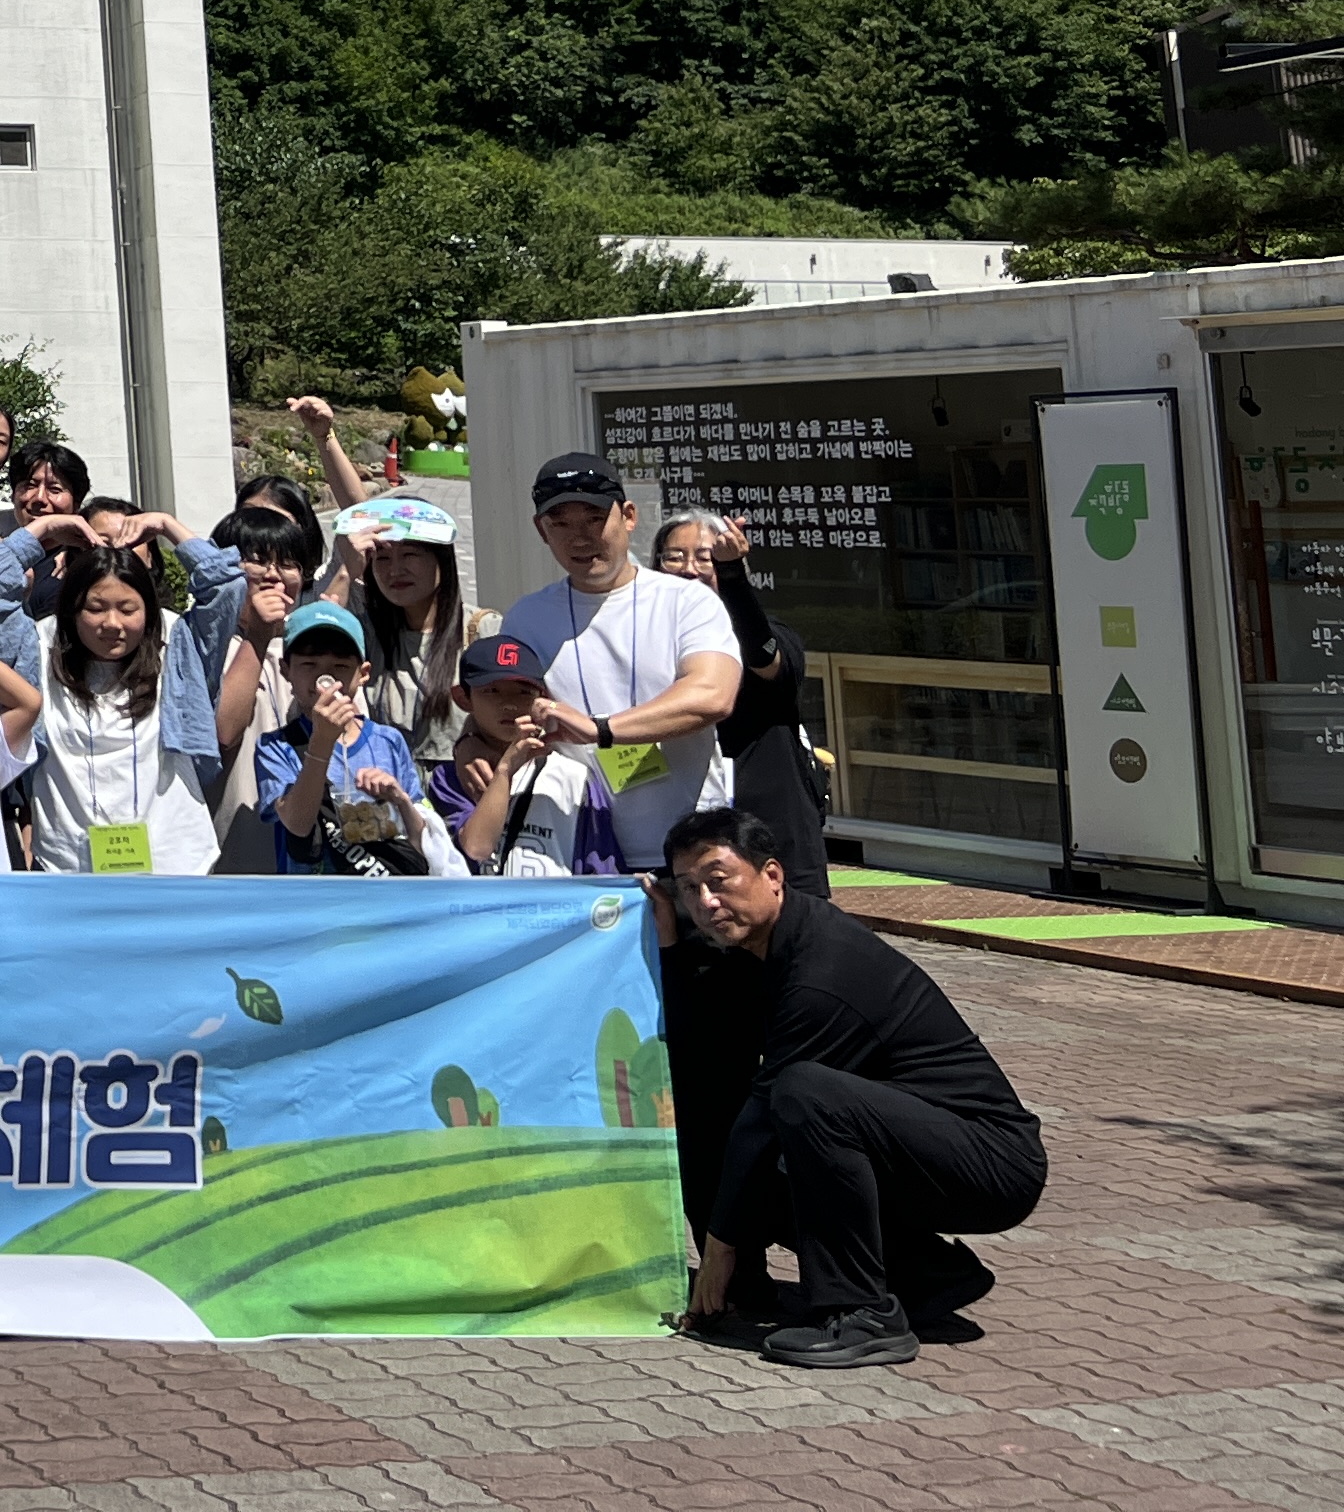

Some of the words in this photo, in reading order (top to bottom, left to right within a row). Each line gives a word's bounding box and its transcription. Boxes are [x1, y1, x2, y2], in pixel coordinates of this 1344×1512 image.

[699, 402, 738, 419] 되겠네.
[605, 426, 647, 444] 섬진강이
[651, 425, 695, 442] 흐르다가
[700, 423, 734, 440] 바다를
[739, 422, 775, 439] 만나기
[779, 421, 791, 438] 전
[827, 418, 866, 436] 고르는
[707, 444, 742, 461] 재첩도
[746, 443, 771, 461] 많이
[775, 442, 812, 460] 잡히고
[859, 439, 913, 459] 반짝이는
[709, 486, 733, 503] 죽은
[738, 486, 773, 504] 어머니
[777, 486, 815, 503] 손목을
[820, 486, 846, 503] 꼬옥
[782, 508, 819, 525] 후두둑
[824, 507, 877, 525] 날아오른
[798, 530, 824, 547] 작은
[829, 530, 887, 548] 마당으로.
